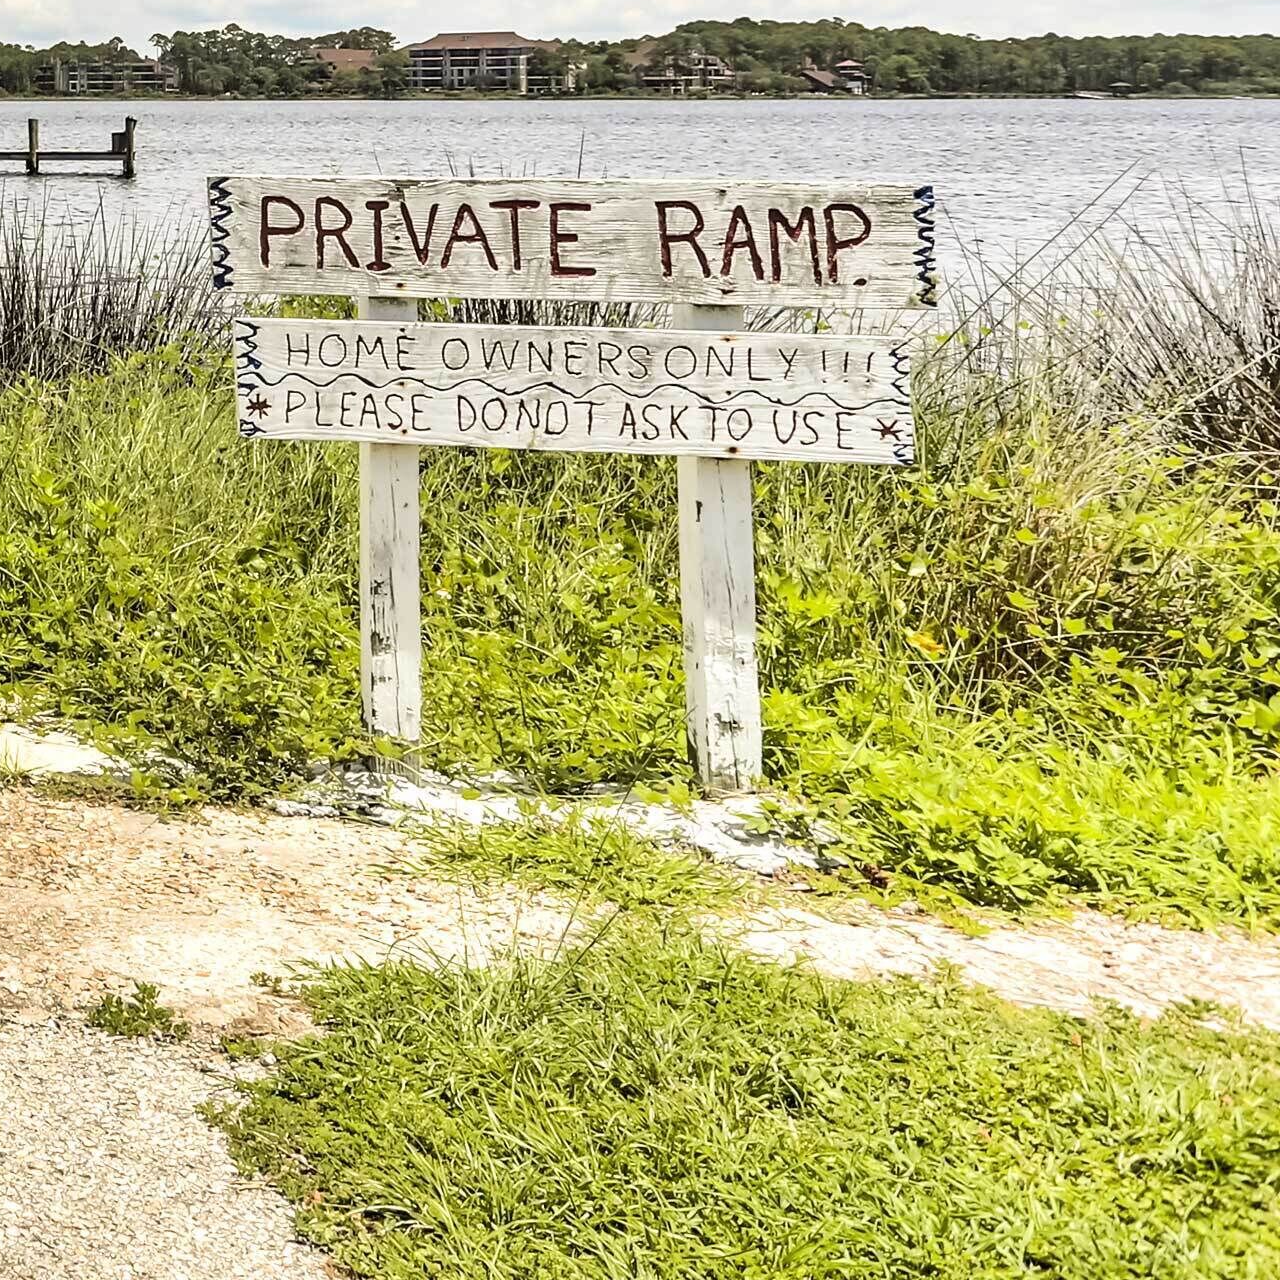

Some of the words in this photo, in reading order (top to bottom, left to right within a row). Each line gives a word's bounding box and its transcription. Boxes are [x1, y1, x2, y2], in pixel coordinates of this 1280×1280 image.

[260, 195, 596, 276] PRIVATE
[655, 200, 872, 286] RAMP.
[285, 333, 416, 371] HOME
[285, 390, 434, 432] PLEASE
[619, 402, 689, 441] ASK
[698, 405, 753, 442] TO
[772, 410, 856, 450] USE
